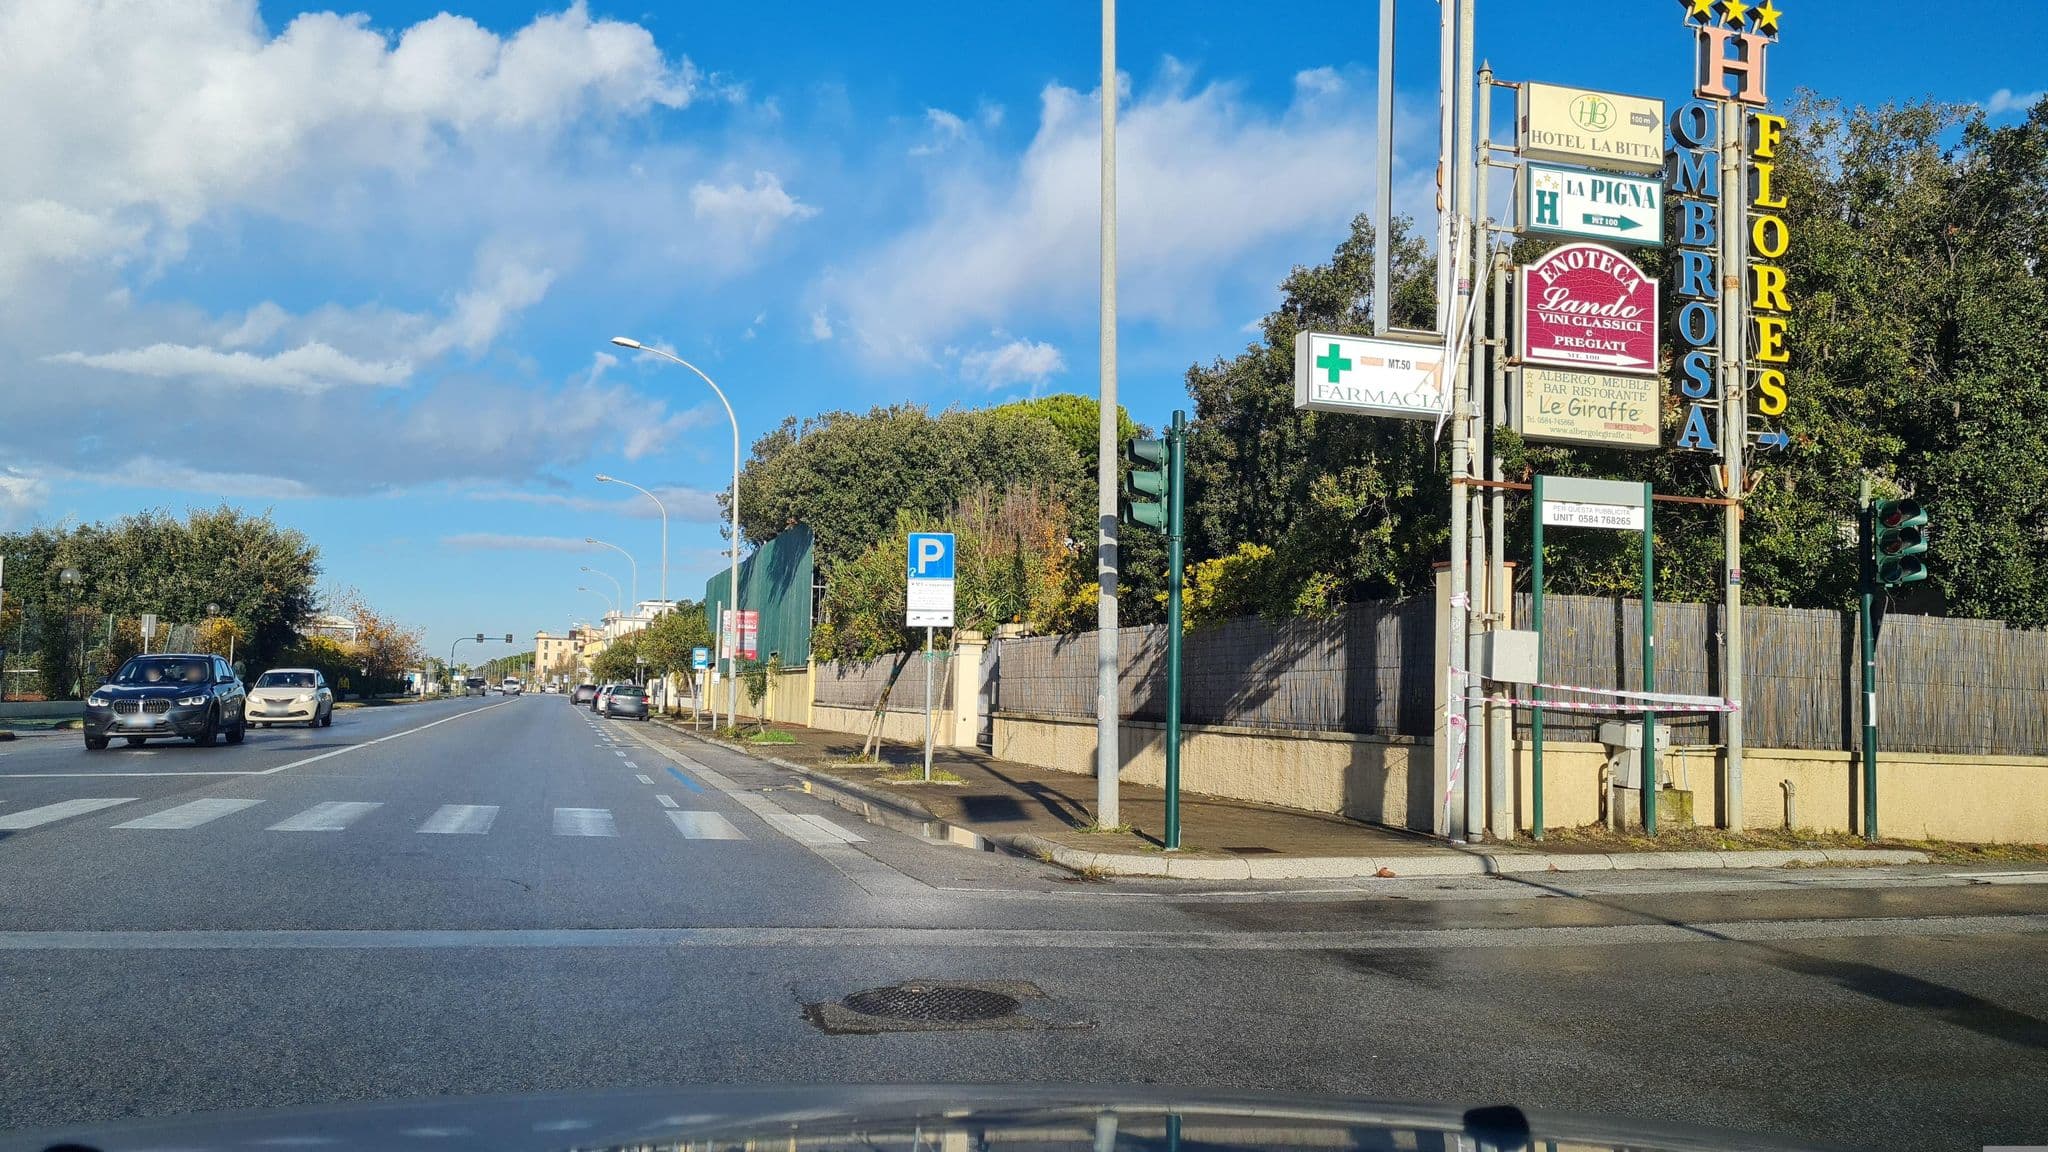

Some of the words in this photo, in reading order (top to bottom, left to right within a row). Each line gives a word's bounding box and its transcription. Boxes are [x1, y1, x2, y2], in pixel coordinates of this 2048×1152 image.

[1701, 27, 1769, 104] H
[1531, 129, 1585, 150] HOTEL
[1592, 138, 1611, 153] LA
[1616, 141, 1660, 159] BITTA
[1536, 189, 1559, 226] H
[1567, 179, 1584, 196] LA
[1590, 179, 1656, 209] PIGNA
[1538, 250, 1640, 296] ENOTECA
[1672, 101, 1720, 450] OMBROSA
[1753, 113, 1792, 417] FLORES
[1537, 286, 1644, 318] Lando
[1539, 312, 1569, 325] VINI
[1572, 316, 1642, 332] CLASSICI
[1554, 335, 1626, 352] PREGIATI
[1388, 358, 1411, 371] MT.50
[1317, 384, 1445, 408] FARMACIA
[1538, 371, 1596, 386] ALBERGO
[1602, 377, 1650, 391] MEUBLE
[1543, 384, 1567, 395] BAR
[1572, 386, 1647, 402] RISTORANTE
[1539, 395, 1562, 415] Le
[1568, 397, 1640, 422] Giraffe
[1553, 513, 1574, 522] UNIT
[1578, 514, 1599, 523] 0584
[917, 538, 945, 574] P
